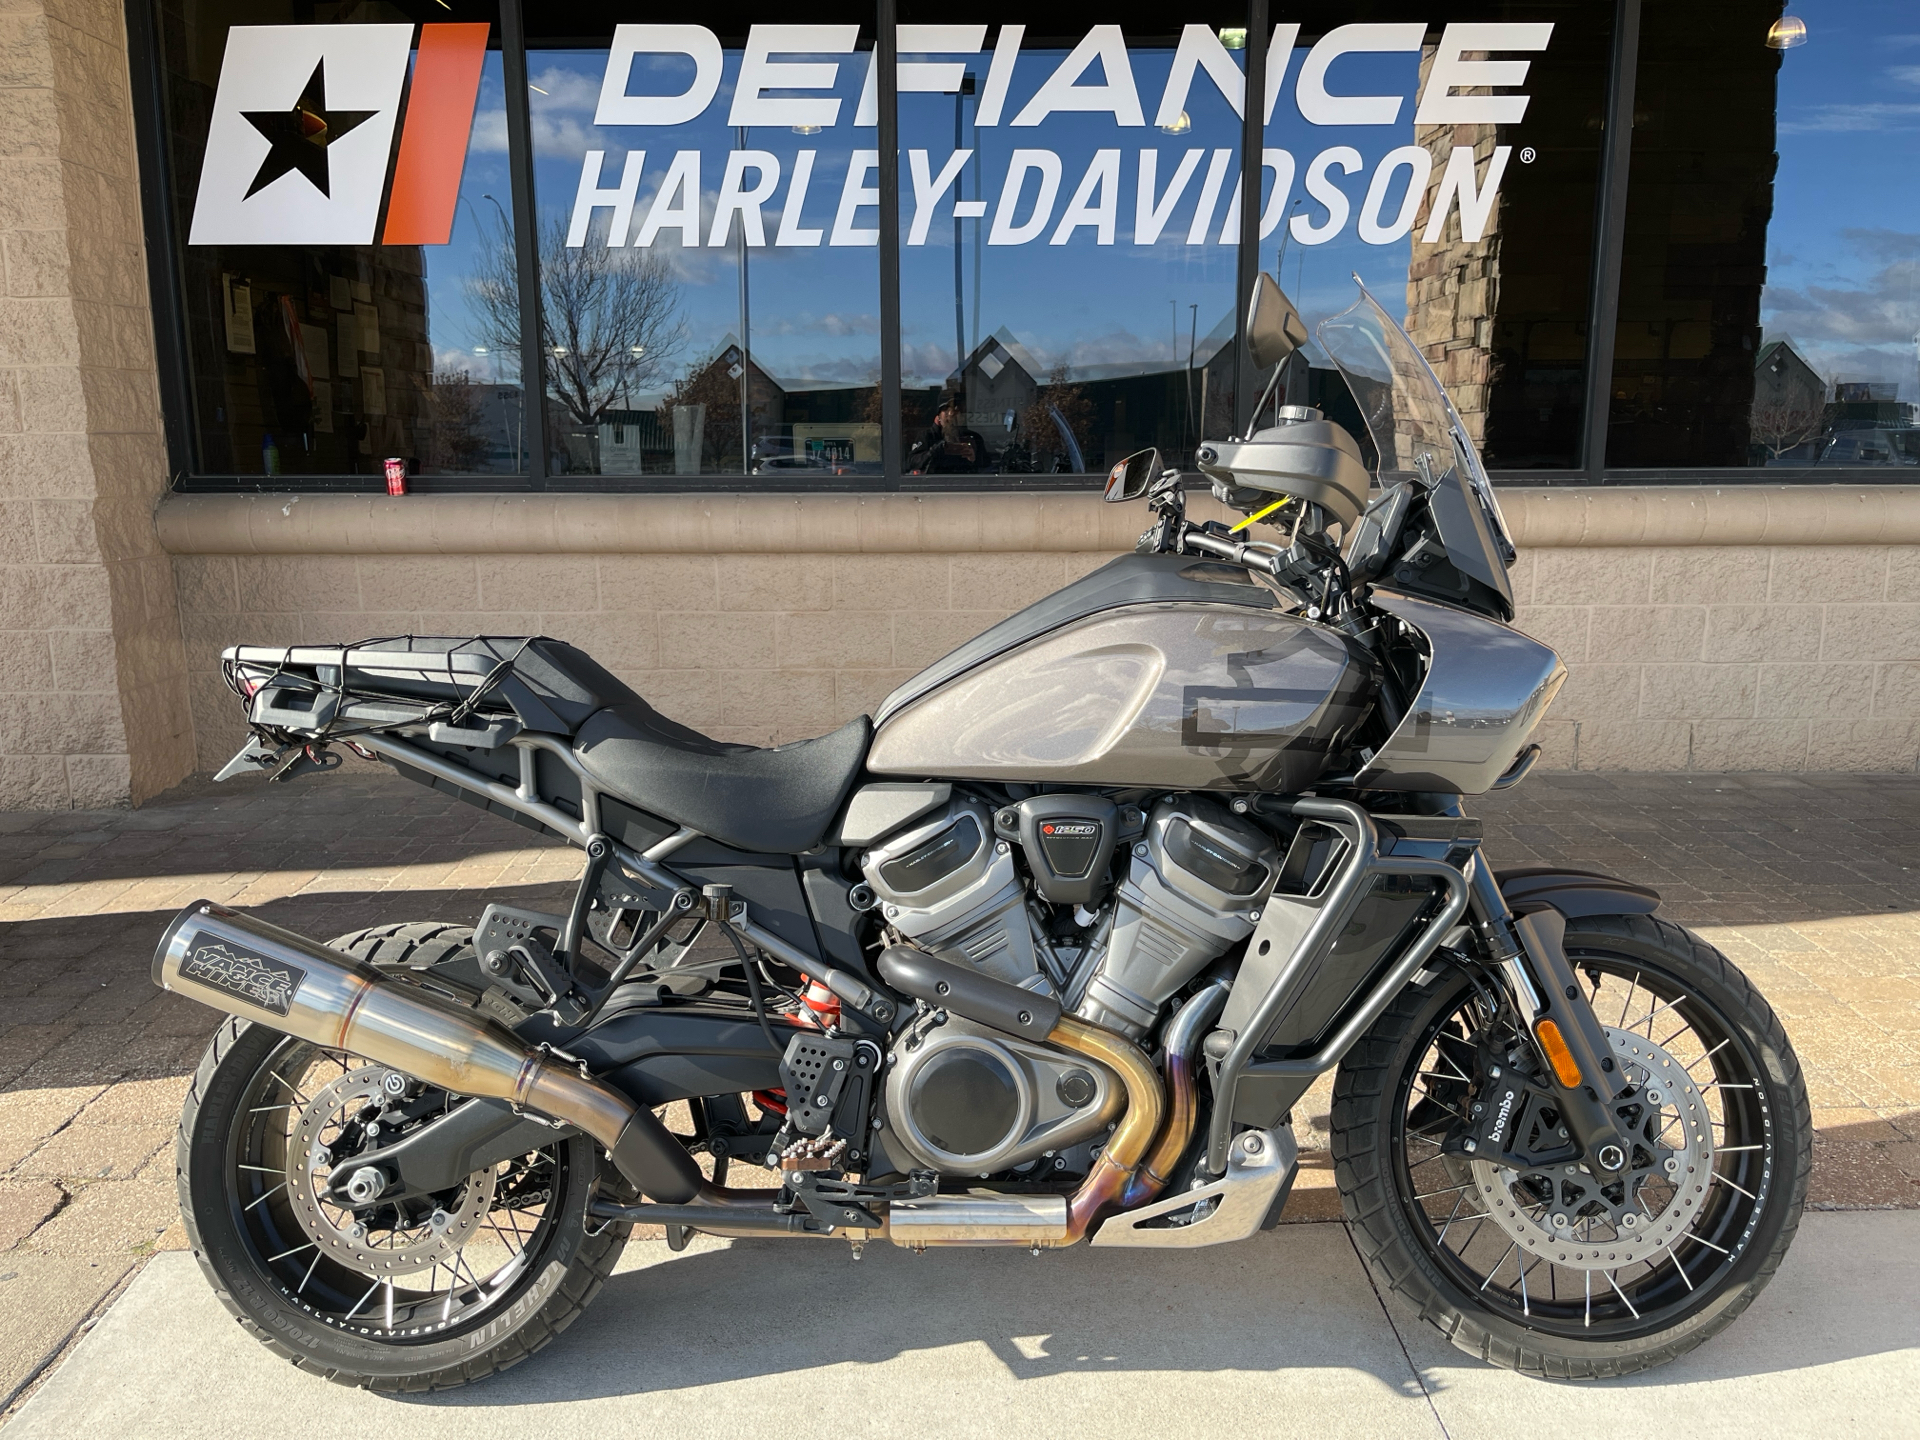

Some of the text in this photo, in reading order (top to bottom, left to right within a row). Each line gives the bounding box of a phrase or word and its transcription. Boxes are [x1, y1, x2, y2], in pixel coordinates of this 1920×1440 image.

[593, 22, 1555, 127] DEFIANCE
[565, 145, 1512, 248] HARLEY-DAVIDSON
[193, 949, 292, 990] VANCE
[1488, 1091, 1514, 1143] brembo
[1728, 1077, 1771, 1263] HARLEY-DAVIDSON
[281, 1286, 460, 1337] HARLEY-DAVIDSON
[470, 1236, 571, 1349] MICHELIN
